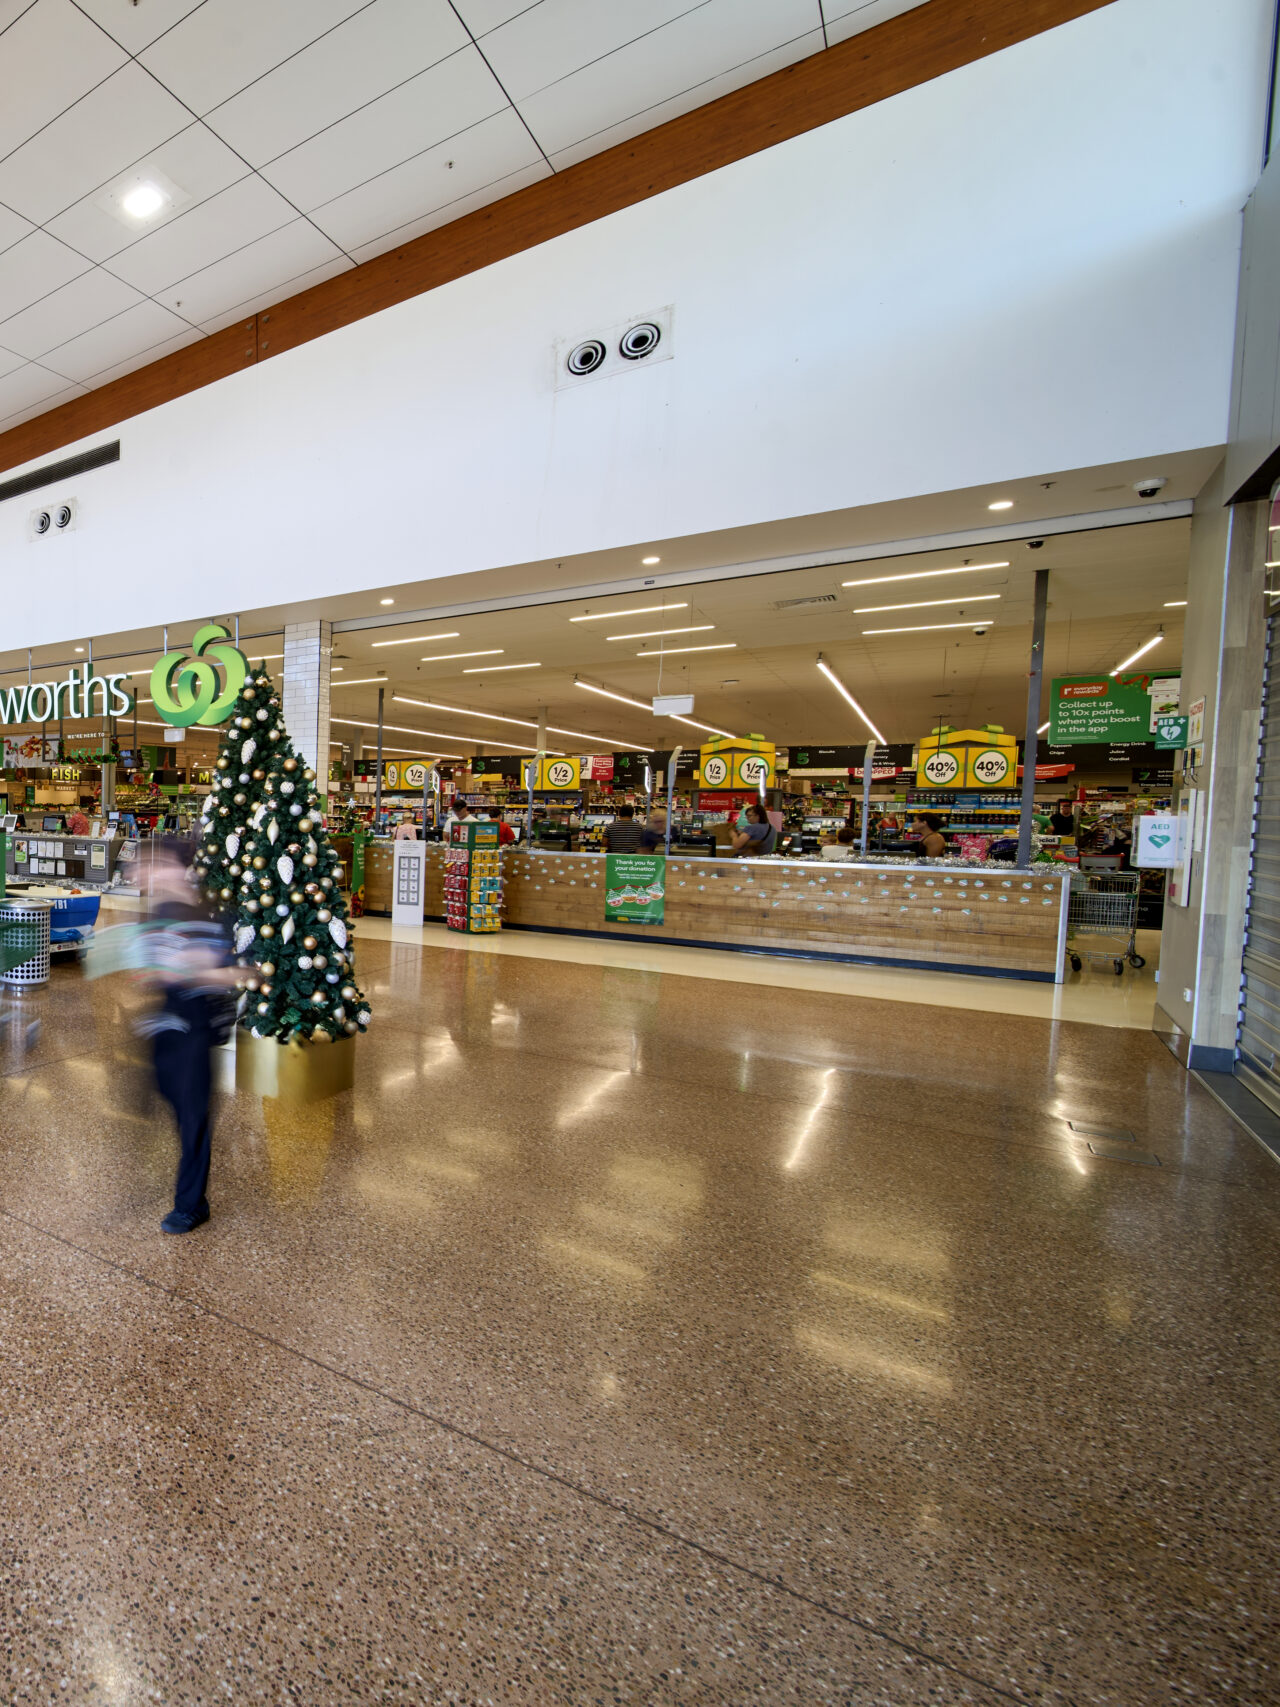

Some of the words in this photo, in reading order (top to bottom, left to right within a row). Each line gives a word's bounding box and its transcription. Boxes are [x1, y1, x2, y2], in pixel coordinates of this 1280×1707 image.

[1059, 701, 1097, 709] Collect
[1091, 708, 1125, 717] points
[1088, 717, 1108, 725] you
[1110, 715, 1141, 723] boost
[796, 752, 810, 765] 5
[357, 763, 366, 774] 2
[475, 760, 486, 771] 3
[709, 764, 721, 775] 1/2
[926, 762, 956, 772] 40%
[976, 760, 1006, 772] 40%
[51, 767, 80, 780] FISH
[410, 769, 423, 779] 1/2
[553, 766, 569, 778] 1/2
